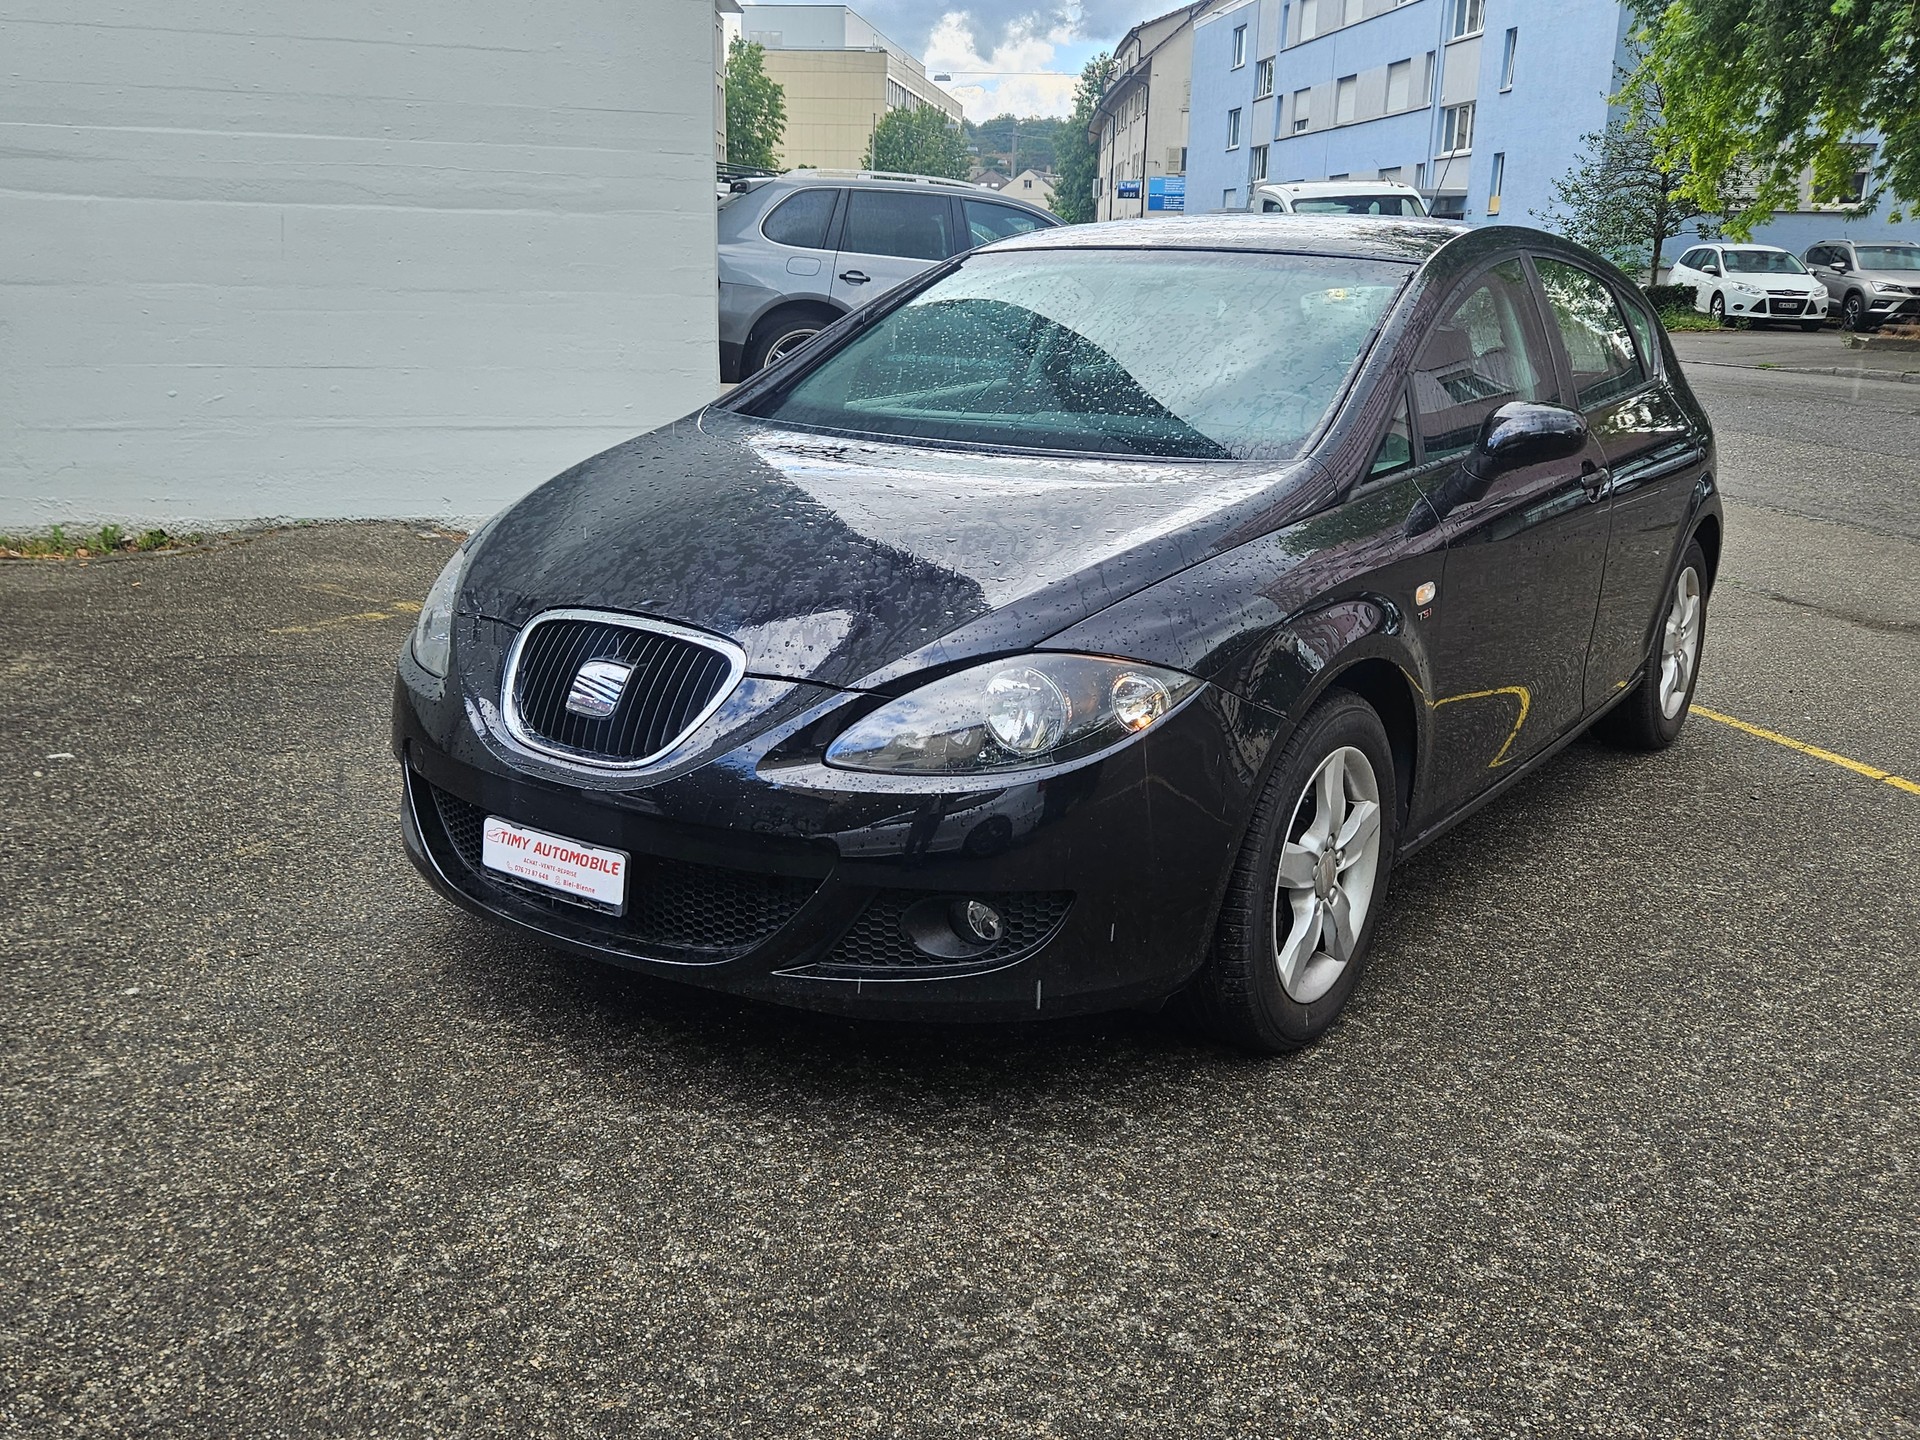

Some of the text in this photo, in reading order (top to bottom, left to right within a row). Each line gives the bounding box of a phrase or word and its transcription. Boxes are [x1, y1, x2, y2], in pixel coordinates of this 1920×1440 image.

[1417, 607, 1432, 621] TSI
[501, 831, 621, 876] TIMY AUTOMOBILE
